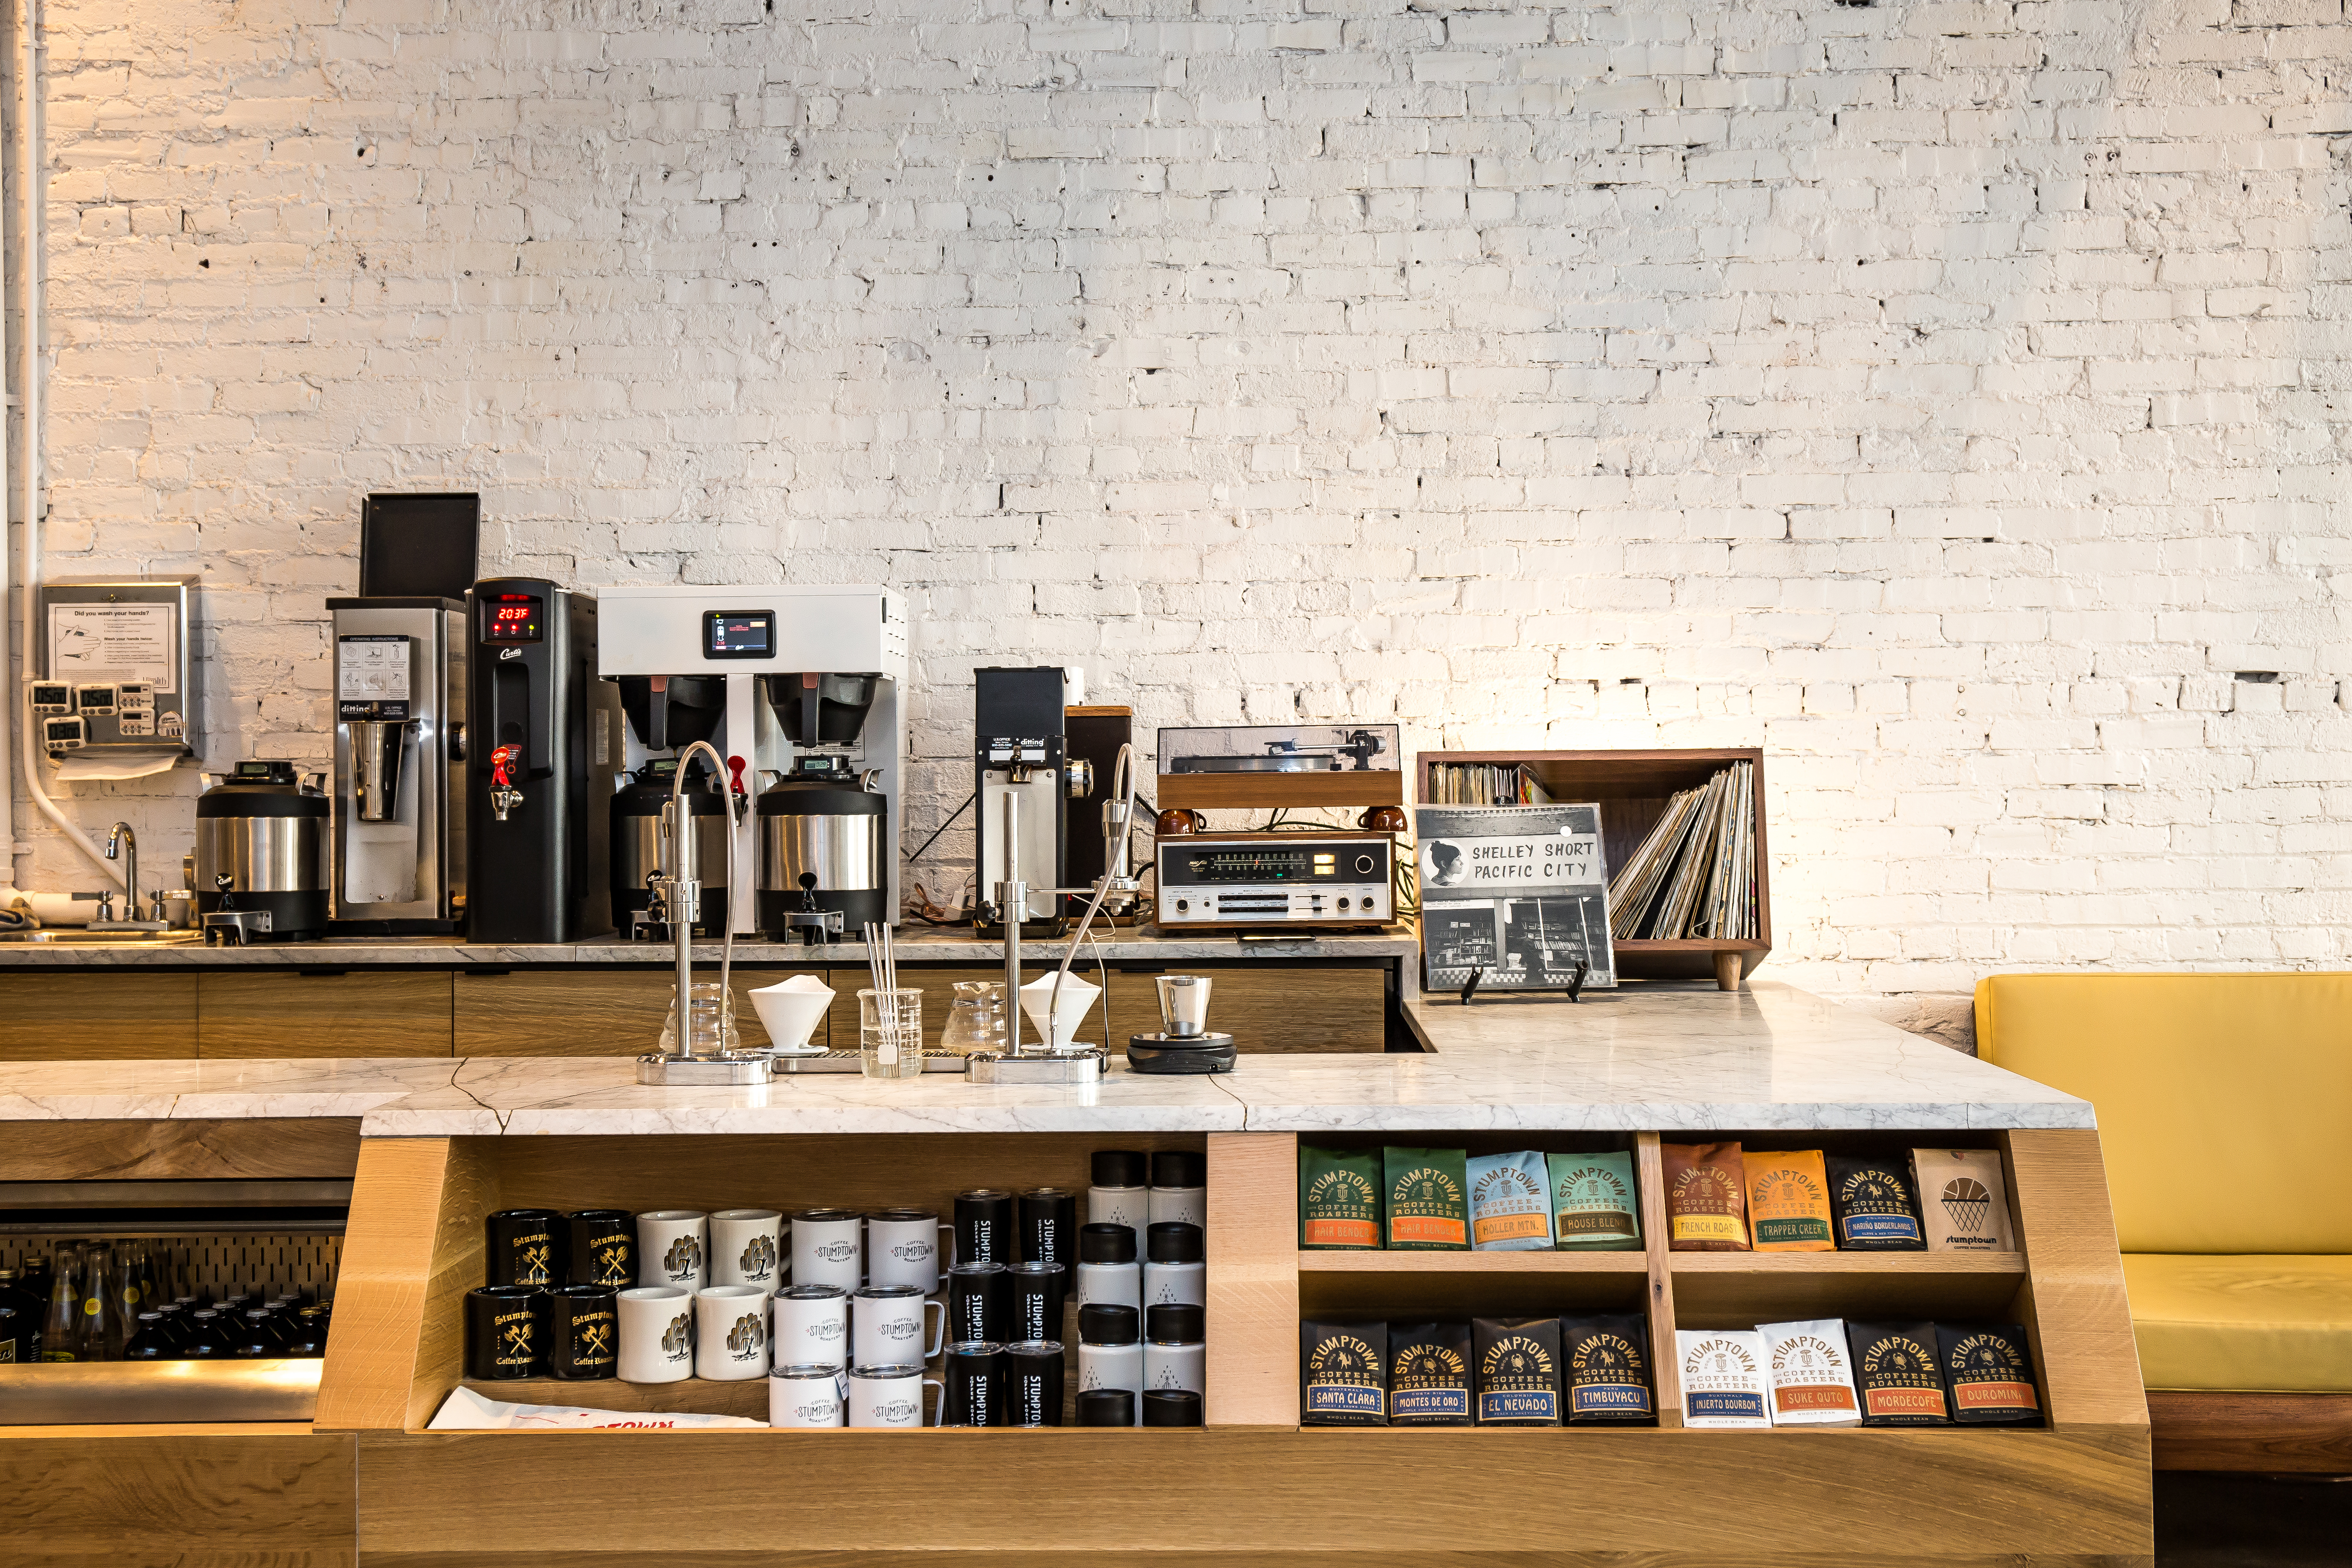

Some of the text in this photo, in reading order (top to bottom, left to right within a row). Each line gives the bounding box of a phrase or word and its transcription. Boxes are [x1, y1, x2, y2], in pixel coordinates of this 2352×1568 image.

[500, 649, 521, 659] Curtis
[1473, 842, 1594, 859] SHELLEY SHORT
[1474, 863, 1586, 879] PACIFIC CITY
[1309, 1170, 1375, 1204] STUMPTOWN
[1394, 1168, 1461, 1202] STUMPTOWN
[1473, 1167, 1541, 1201] STUMPTOWN
[1559, 1167, 1627, 1198] STUMPTOWN
[1673, 1167, 1739, 1200] STUMPTOWN
[1755, 1170, 1822, 1202] STUMPTOWN
[1842, 1170, 1908, 1202] STUMPTOWN
[1483, 1199, 1533, 1209] COFFEE
[1396, 1209, 1460, 1217] ROASTERS
[1477, 1205, 1541, 1217] ROASTERS
[1401, 1223, 1456, 1236] HAIR BENDER
[1483, 1220, 1539, 1235] HOLLER MTN.
[1568, 1218, 1625, 1229] HOUSE BLEND
[1681, 1222, 1737, 1234] FRENCH ROAST
[1852, 1221, 1911, 1230] NARIÑO BORDERLANDS
[1314, 1226, 1369, 1237] HAIR BENDER
[1764, 1224, 1822, 1237] TRAPPER CREEK
[981, 1221, 990, 1262] STUMPTO
[1044, 1219, 1054, 1262] STUMPTO
[1946, 1235, 1997, 1245] stumptown
[818, 1244, 856, 1257] STUMPTOWN
[894, 1244, 932, 1257] STUMPTOWN
[972, 1295, 983, 1342] STUMPTO
[1033, 1294, 1043, 1338] STUMPTO
[881, 1322, 920, 1335] STUMPTOWN
[1311, 1335, 1379, 1371] STUMPTOWN
[1482, 1336, 1553, 1374] STUMPTOWN
[1573, 1334, 1642, 1369] STUMPTOWN
[1686, 1339, 1757, 1374] STUMPTOWN
[1773, 1336, 1843, 1370] STUMPTOWN
[1865, 1337, 1935, 1372] STUMPTOWN
[1952, 1335, 2023, 1369] STUMPTOWN
[496, 1356, 516, 1365] Coffee
[574, 1357, 593, 1366] Coffee
[1395, 1344, 1465, 1374] STUMPTOWN
[1311, 1379, 1378, 1387] ROASTERS
[1396, 1382, 1463, 1390] ROASTERS
[1776, 1377, 1844, 1385] ROASTERS
[1030, 1375, 1041, 1424] STUMPTO
[1317, 1393, 1375, 1406] SANTA CLARA
[1400, 1397, 1458, 1408] MONTES DE ORO
[1583, 1392, 1640, 1403] TIMBUYACU
[1788, 1392, 1844, 1404] SUKE QUTO
[1877, 1397, 1937, 1407] MORDECOFE
[798, 1403, 839, 1418] STUMPTOWN
[876, 1403, 917, 1417] STUMPTOWN
[1488, 1399, 1547, 1411] EL NEVADO
[1696, 1400, 1756, 1410] INJERTO BOURBON
